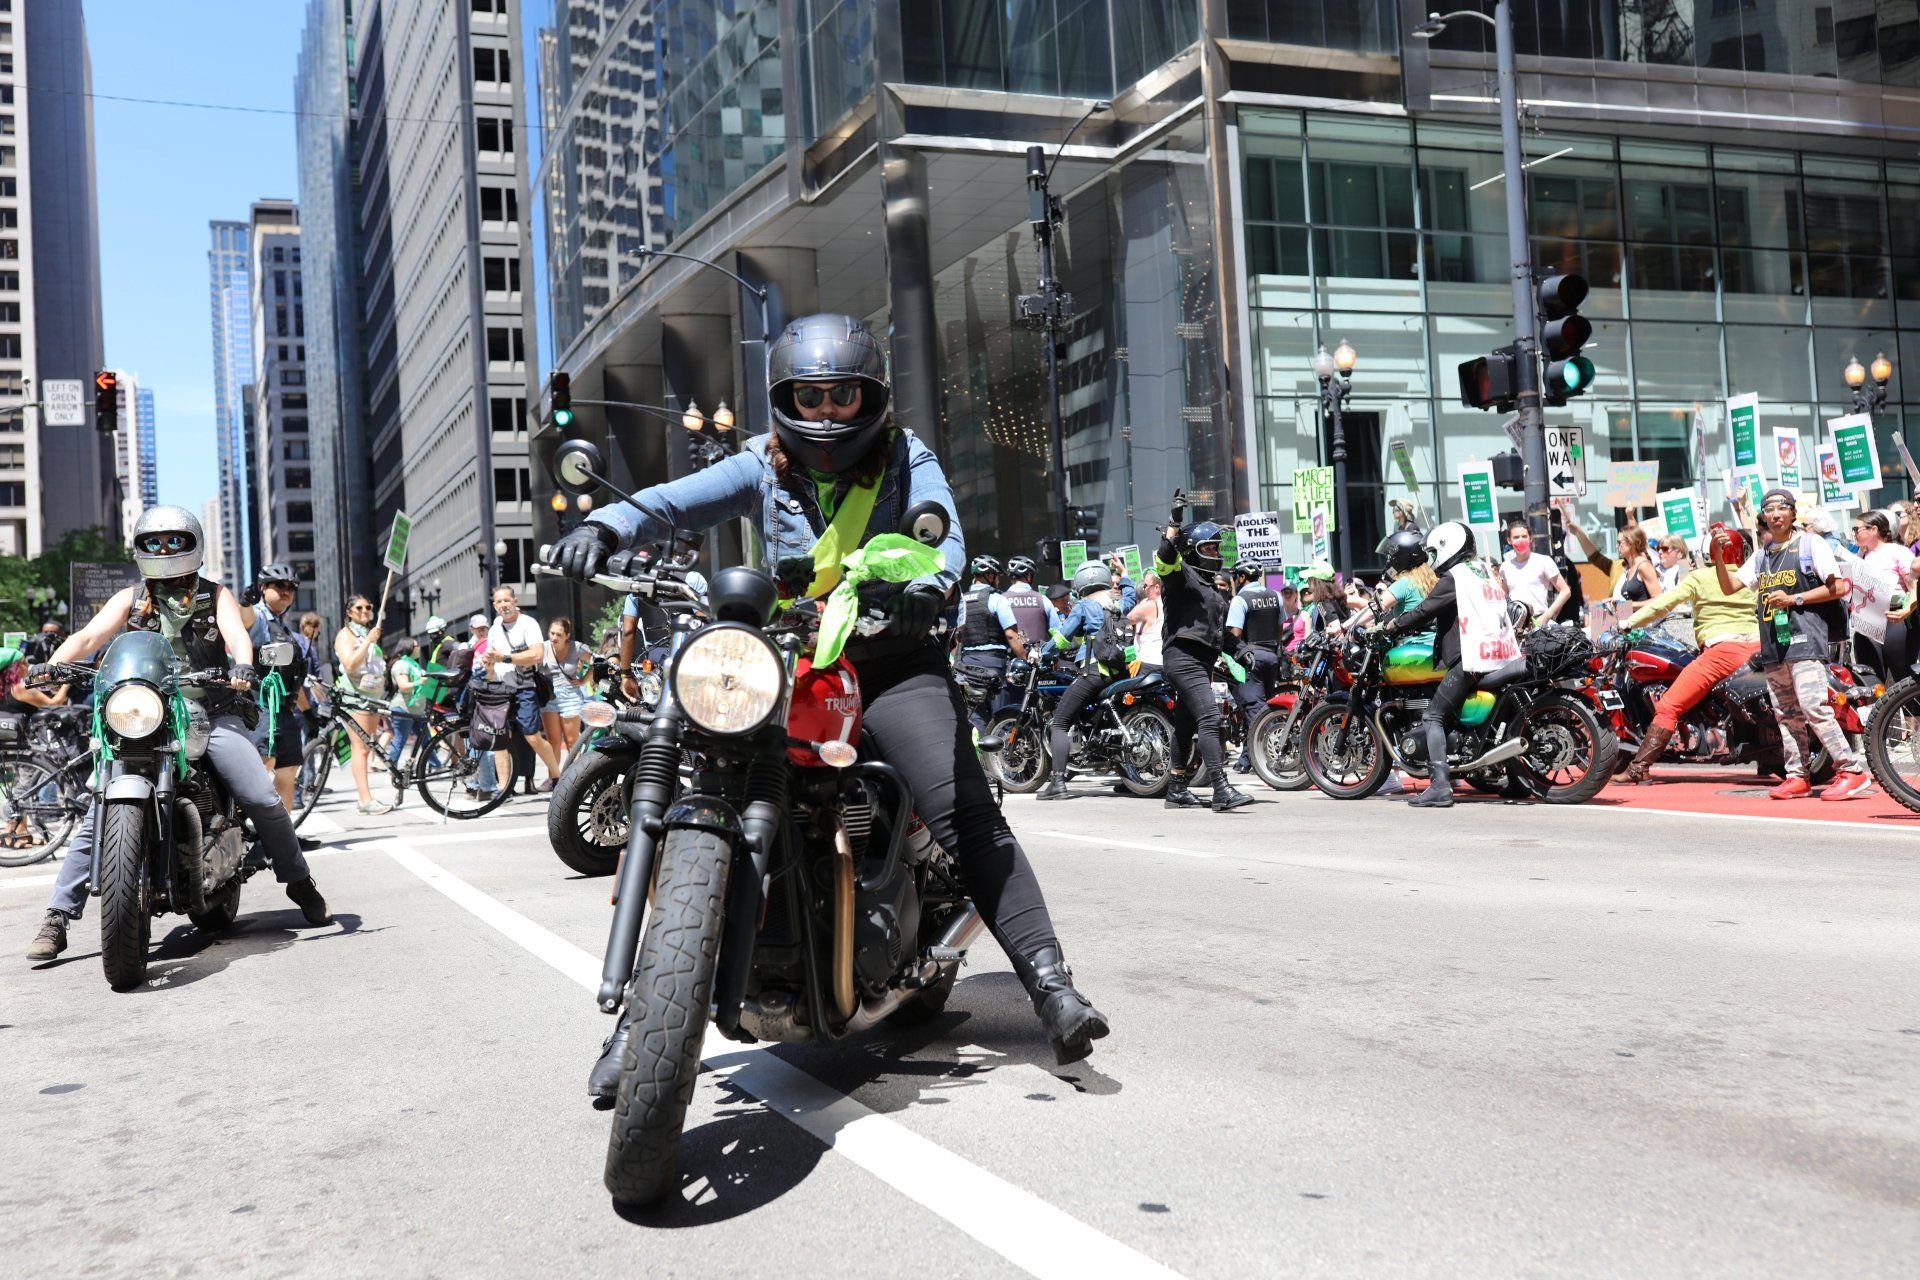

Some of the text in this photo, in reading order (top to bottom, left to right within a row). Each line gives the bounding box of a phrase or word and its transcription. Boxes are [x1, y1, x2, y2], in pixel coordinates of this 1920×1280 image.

[46, 383, 79, 392] LEFT ON
[51, 393, 77, 401] GREEN
[54, 412, 74, 421] ONLY
[1548, 432, 1576, 447] ONE
[1294, 468, 1332, 487] MARCH
[1236, 518, 1277, 528] ABOLISH
[1246, 528, 1269, 537] THE
[1239, 540, 1279, 550] SUPREME
[1240, 550, 1280, 559] COURT!
[1009, 596, 1038, 606] POLICE
[1252, 597, 1276, 608] POLICE
[825, 698, 860, 713] TRIUM
